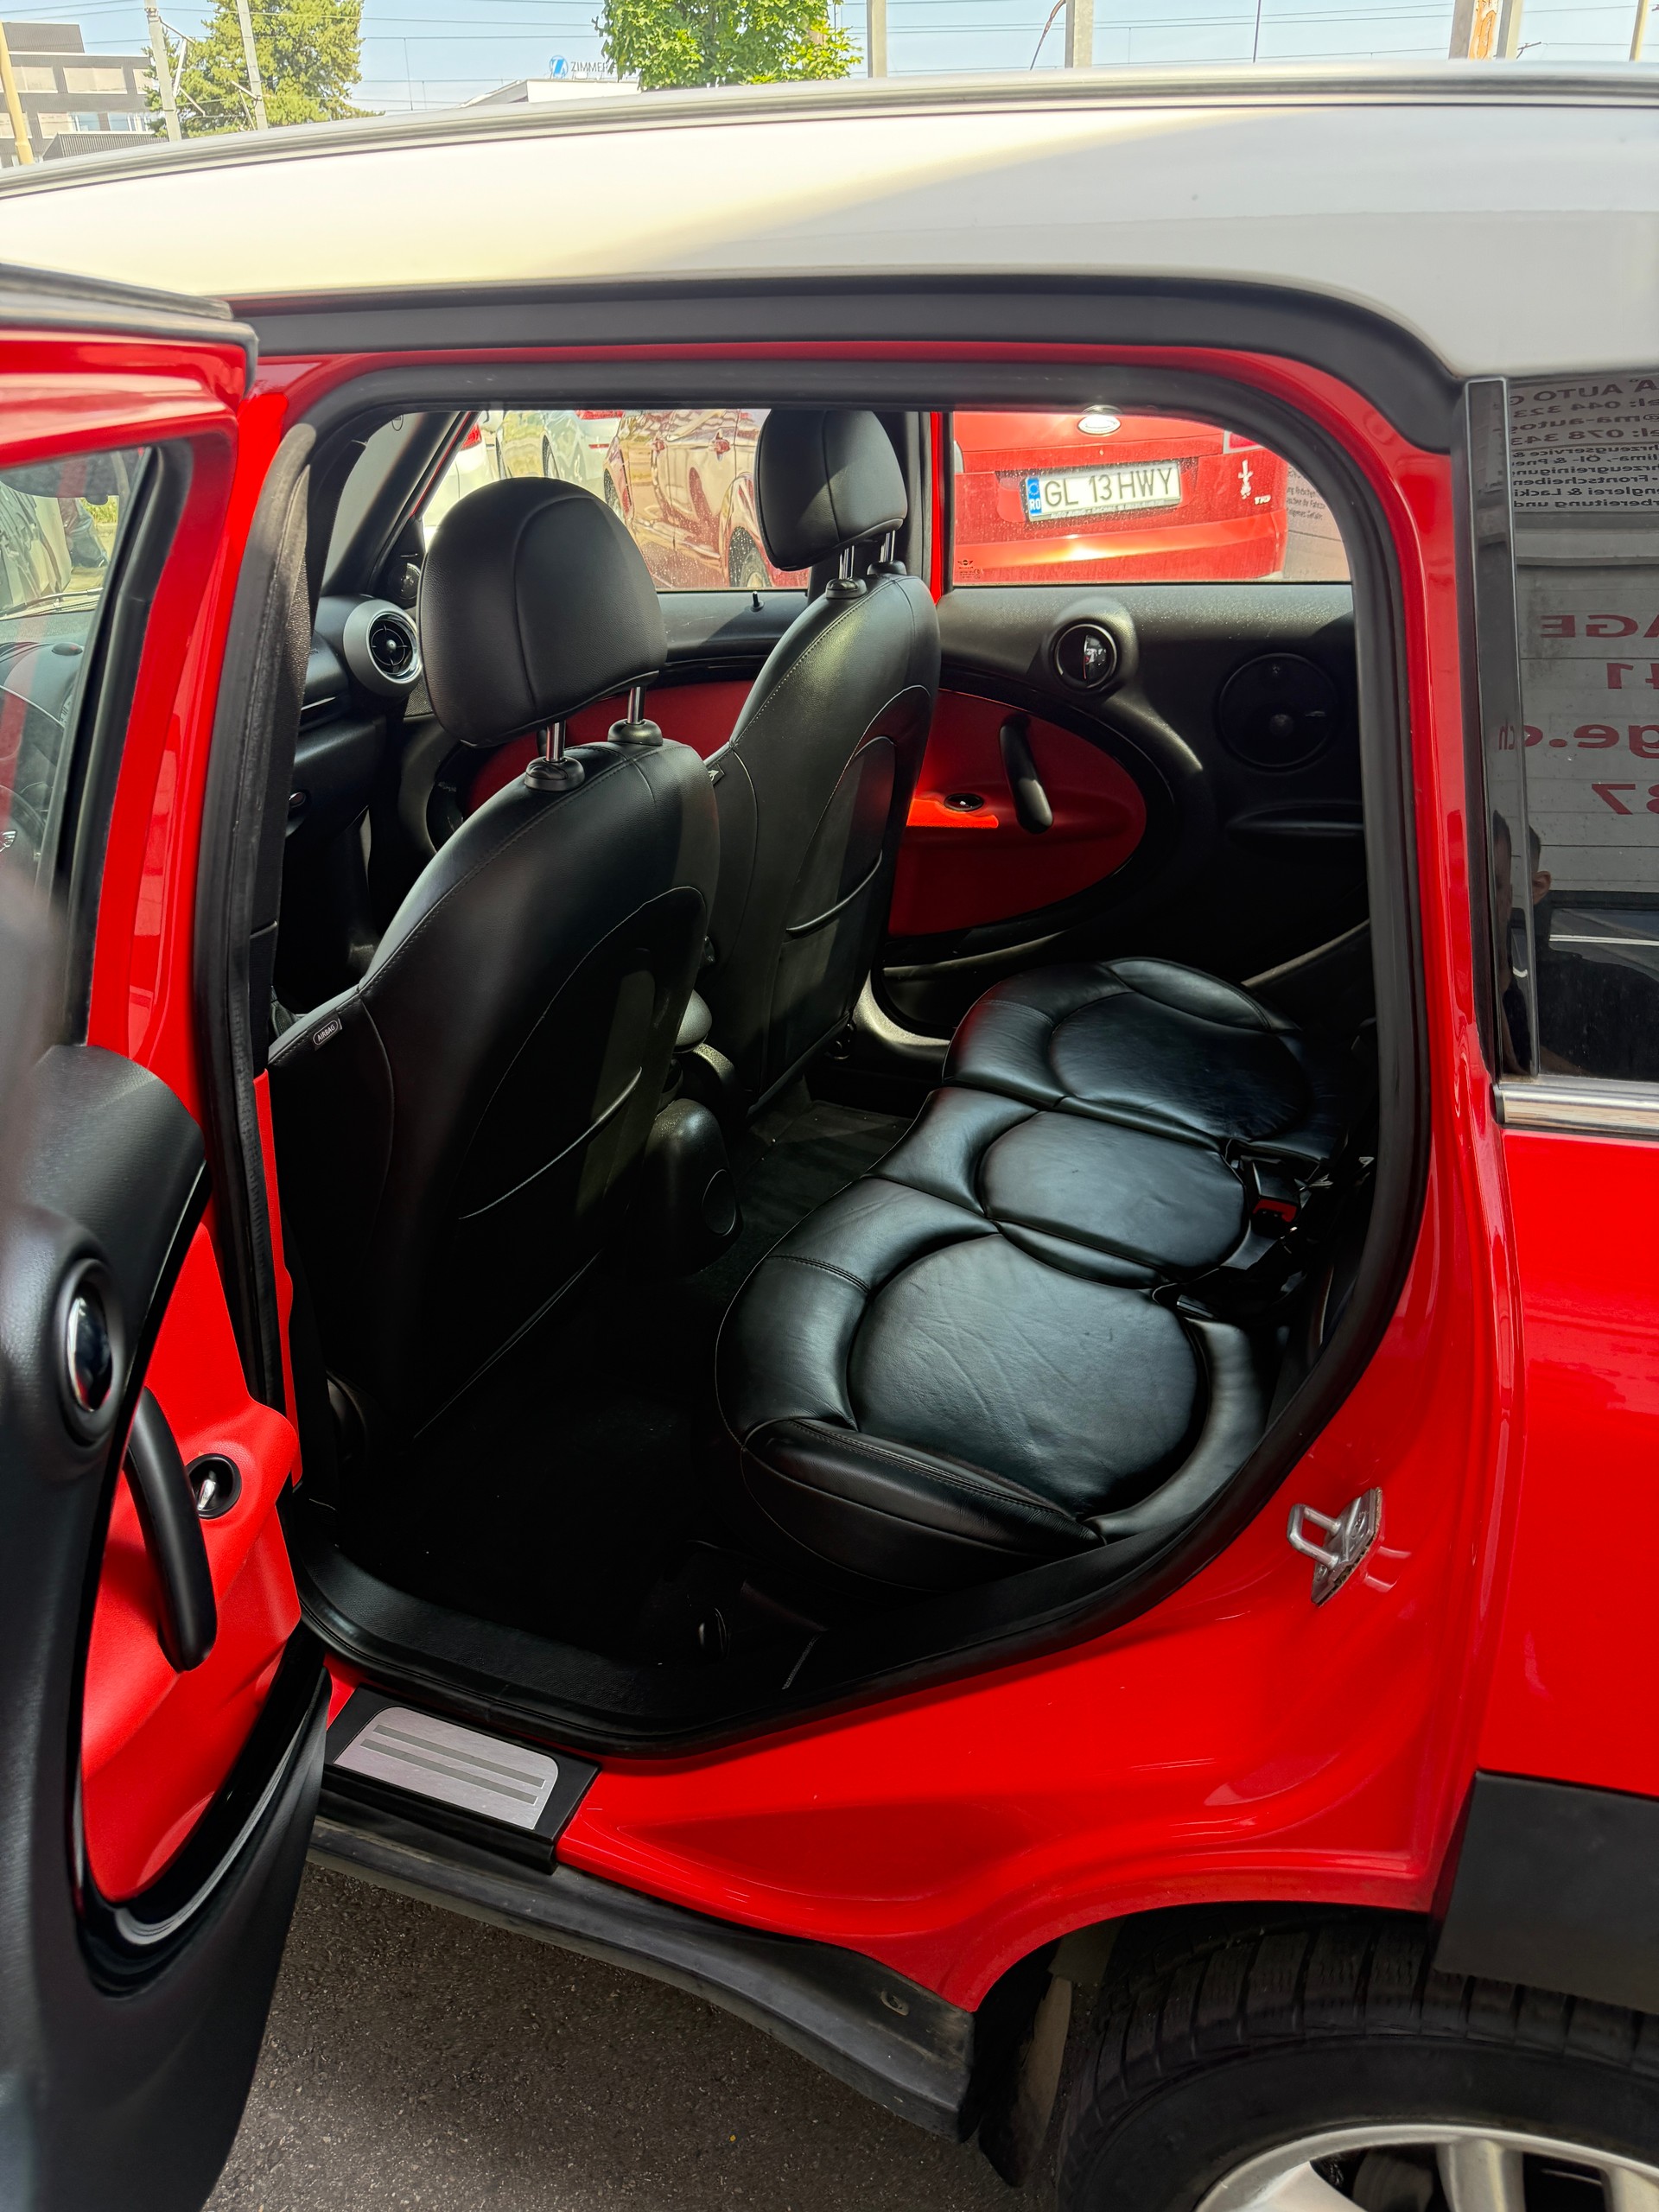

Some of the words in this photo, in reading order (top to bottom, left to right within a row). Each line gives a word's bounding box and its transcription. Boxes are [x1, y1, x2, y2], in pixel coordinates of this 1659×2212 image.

[1029, 499, 1042, 510] RO
[1044, 478, 1079, 508] GL
[1089, 474, 1113, 504] 13
[1116, 467, 1173, 499] HWY
[317, 1024, 335, 1041] AIRBAG
